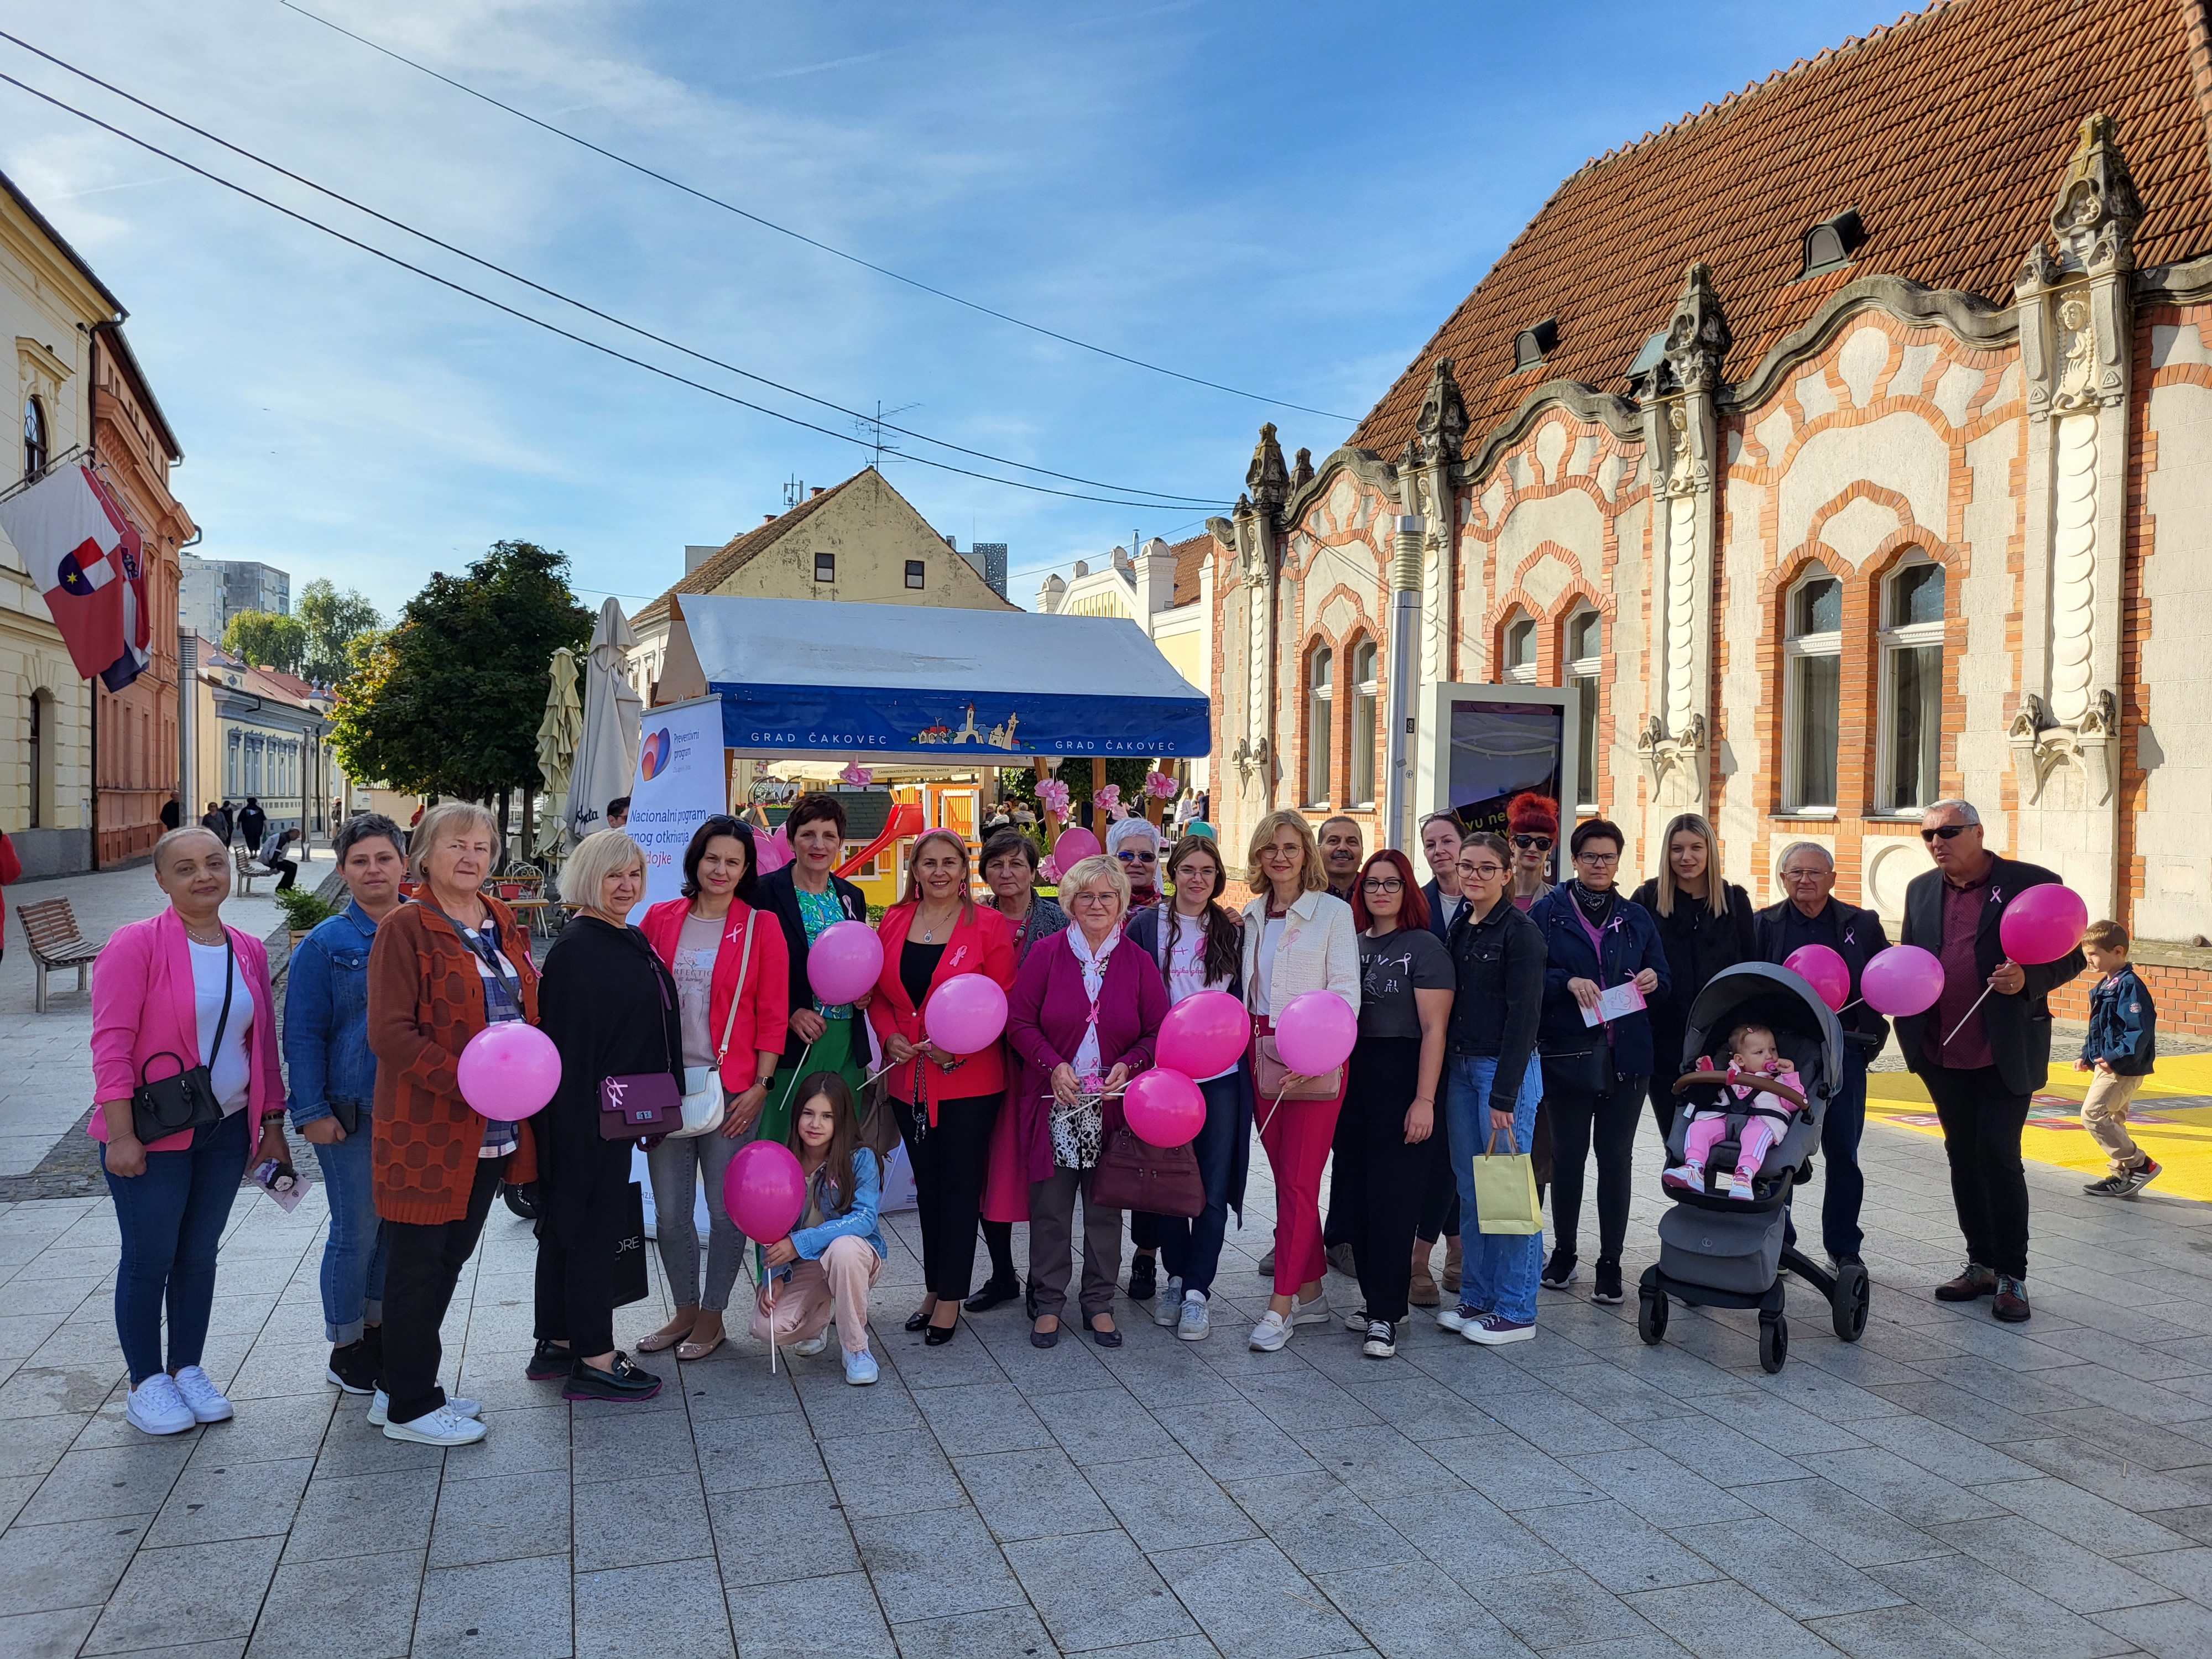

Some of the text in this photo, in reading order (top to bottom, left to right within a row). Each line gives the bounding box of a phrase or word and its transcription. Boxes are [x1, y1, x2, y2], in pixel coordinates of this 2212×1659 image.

[750, 732, 887, 745] GRAD ČAKOVEC
[1055, 739, 1175, 751] GRAD ČAKOVEC
[674, 748, 691, 761] program
[629, 808, 706, 825] Nacionalni program
[656, 830, 689, 846] otkrivanja
[1386, 979, 1397, 988] 21
